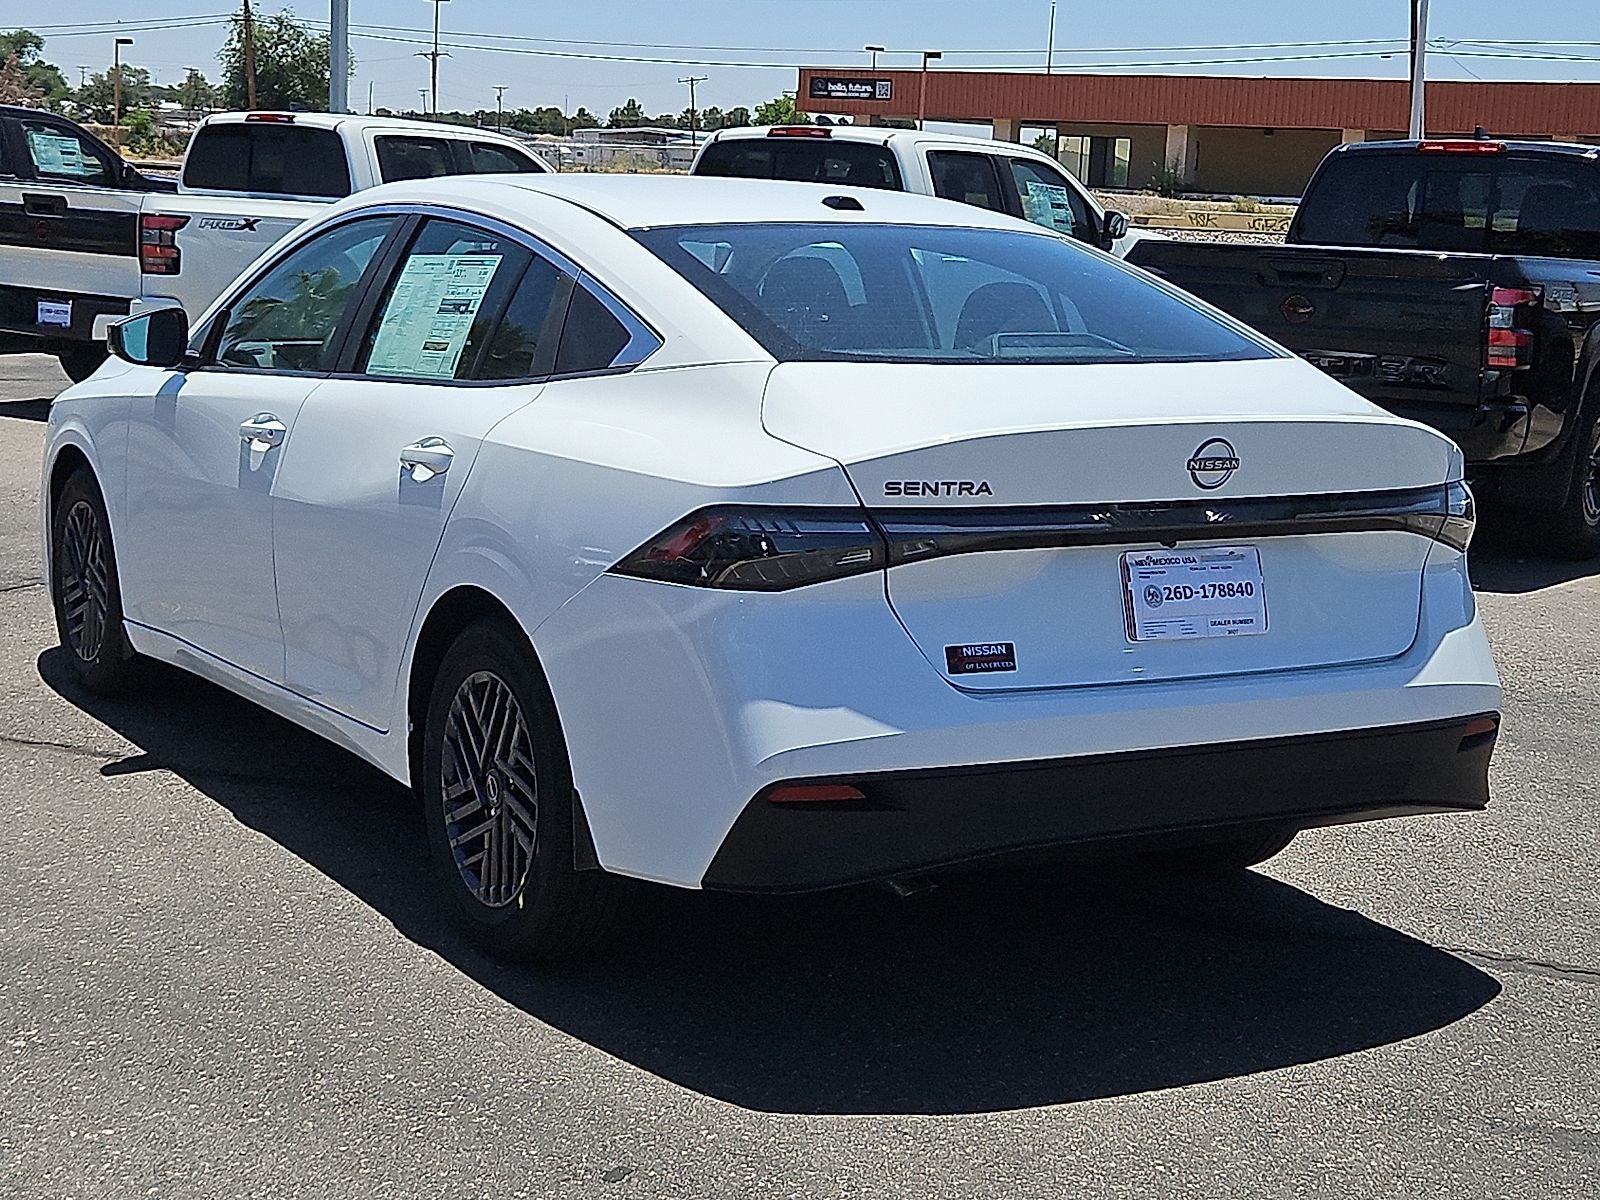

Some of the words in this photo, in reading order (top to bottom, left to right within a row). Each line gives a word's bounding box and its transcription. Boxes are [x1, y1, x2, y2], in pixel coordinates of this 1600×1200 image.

[828, 82, 847, 92] hello,
[1187, 457, 1240, 471] NISSAN
[883, 481, 993, 496] SENTRA
[1152, 556, 1181, 566] MEXICO
[1182, 556, 1198, 565] USA
[1163, 582, 1254, 601] 26D-178840
[1210, 619, 1231, 627] DEALER
[1232, 618, 1254, 626] NUMBER
[962, 644, 1007, 657] NISSAN
